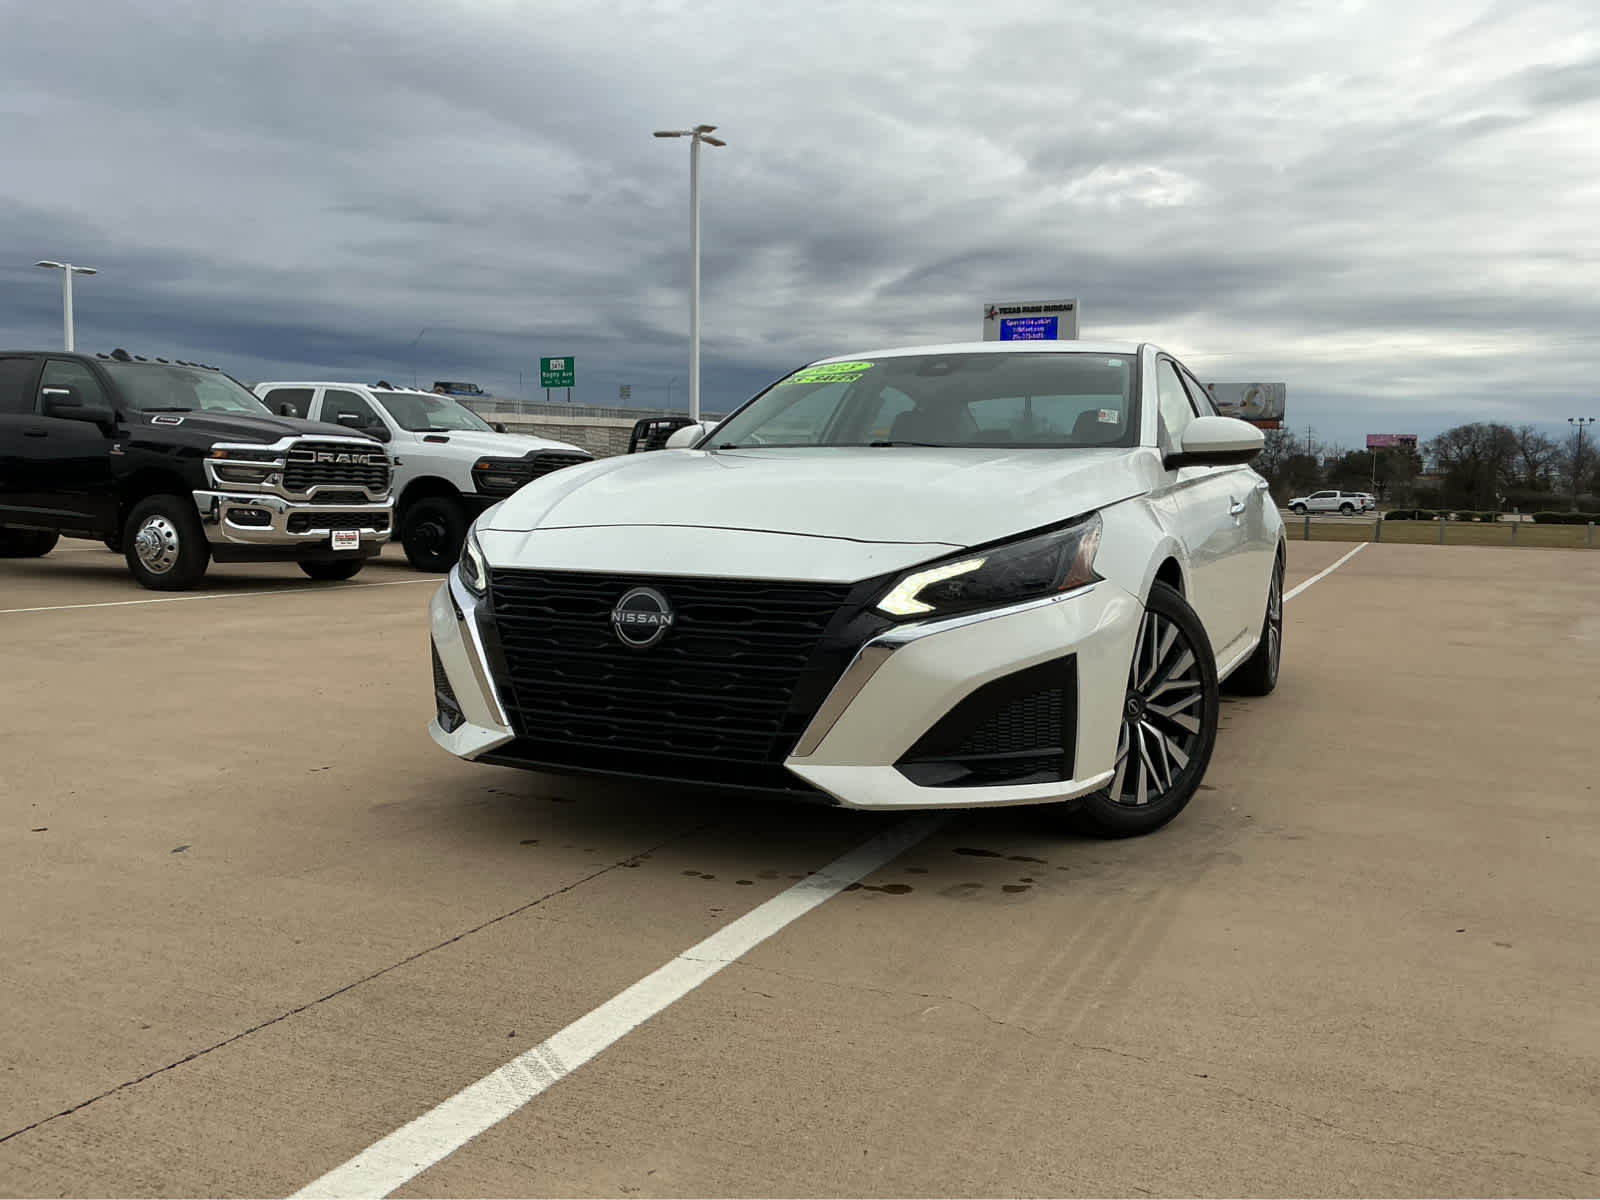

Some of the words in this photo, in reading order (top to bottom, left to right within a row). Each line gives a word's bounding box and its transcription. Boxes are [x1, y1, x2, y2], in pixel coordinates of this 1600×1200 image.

[1044, 304, 1073, 312] BUREAU
[317, 452, 369, 464] RAM
[611, 610, 673, 625] NISSAN
